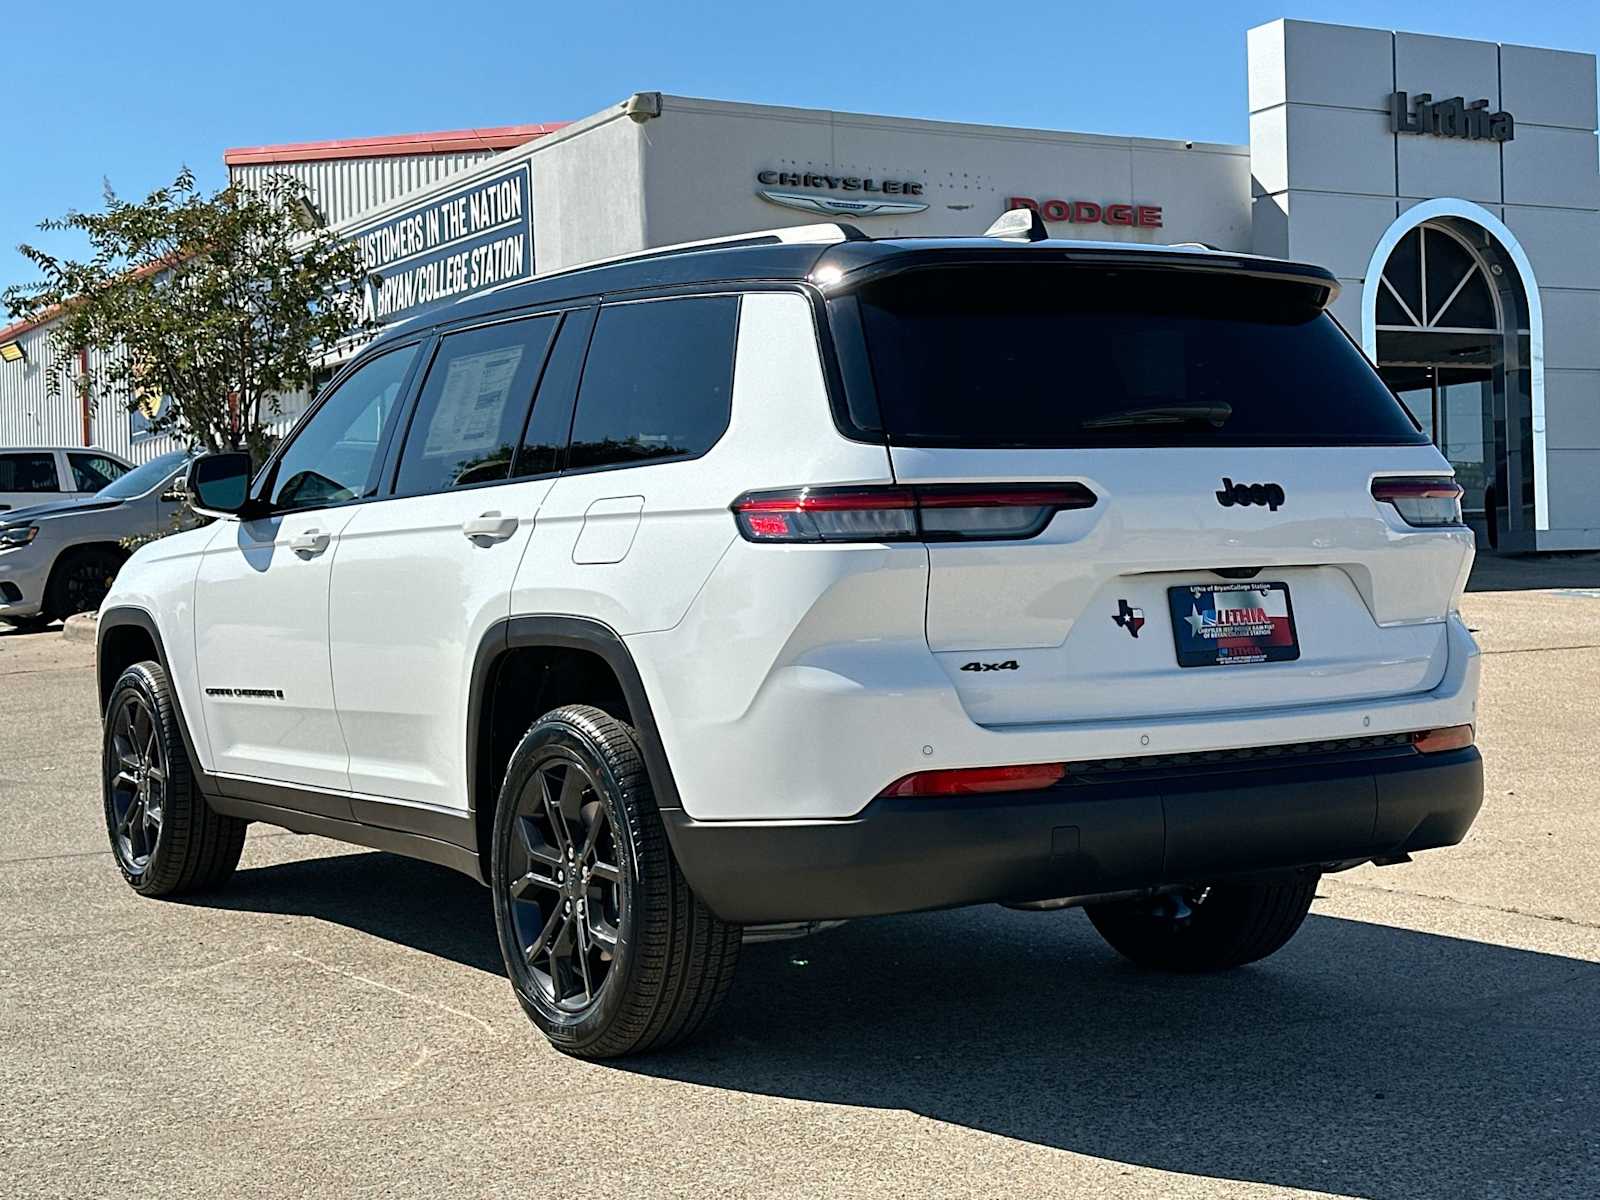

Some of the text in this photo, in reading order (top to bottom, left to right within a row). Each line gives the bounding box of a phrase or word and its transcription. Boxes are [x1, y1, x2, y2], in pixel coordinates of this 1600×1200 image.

[1391, 92, 1514, 141] Lithia
[757, 170, 924, 196] CHRYSLER
[426, 207, 440, 247] IN
[441, 196, 468, 240] THE
[469, 176, 522, 232] NATION
[470, 233, 524, 288] STATION
[1215, 477, 1286, 512] Jeep
[1217, 608, 1269, 625] LITHIA
[960, 660, 1020, 672] 4x4
